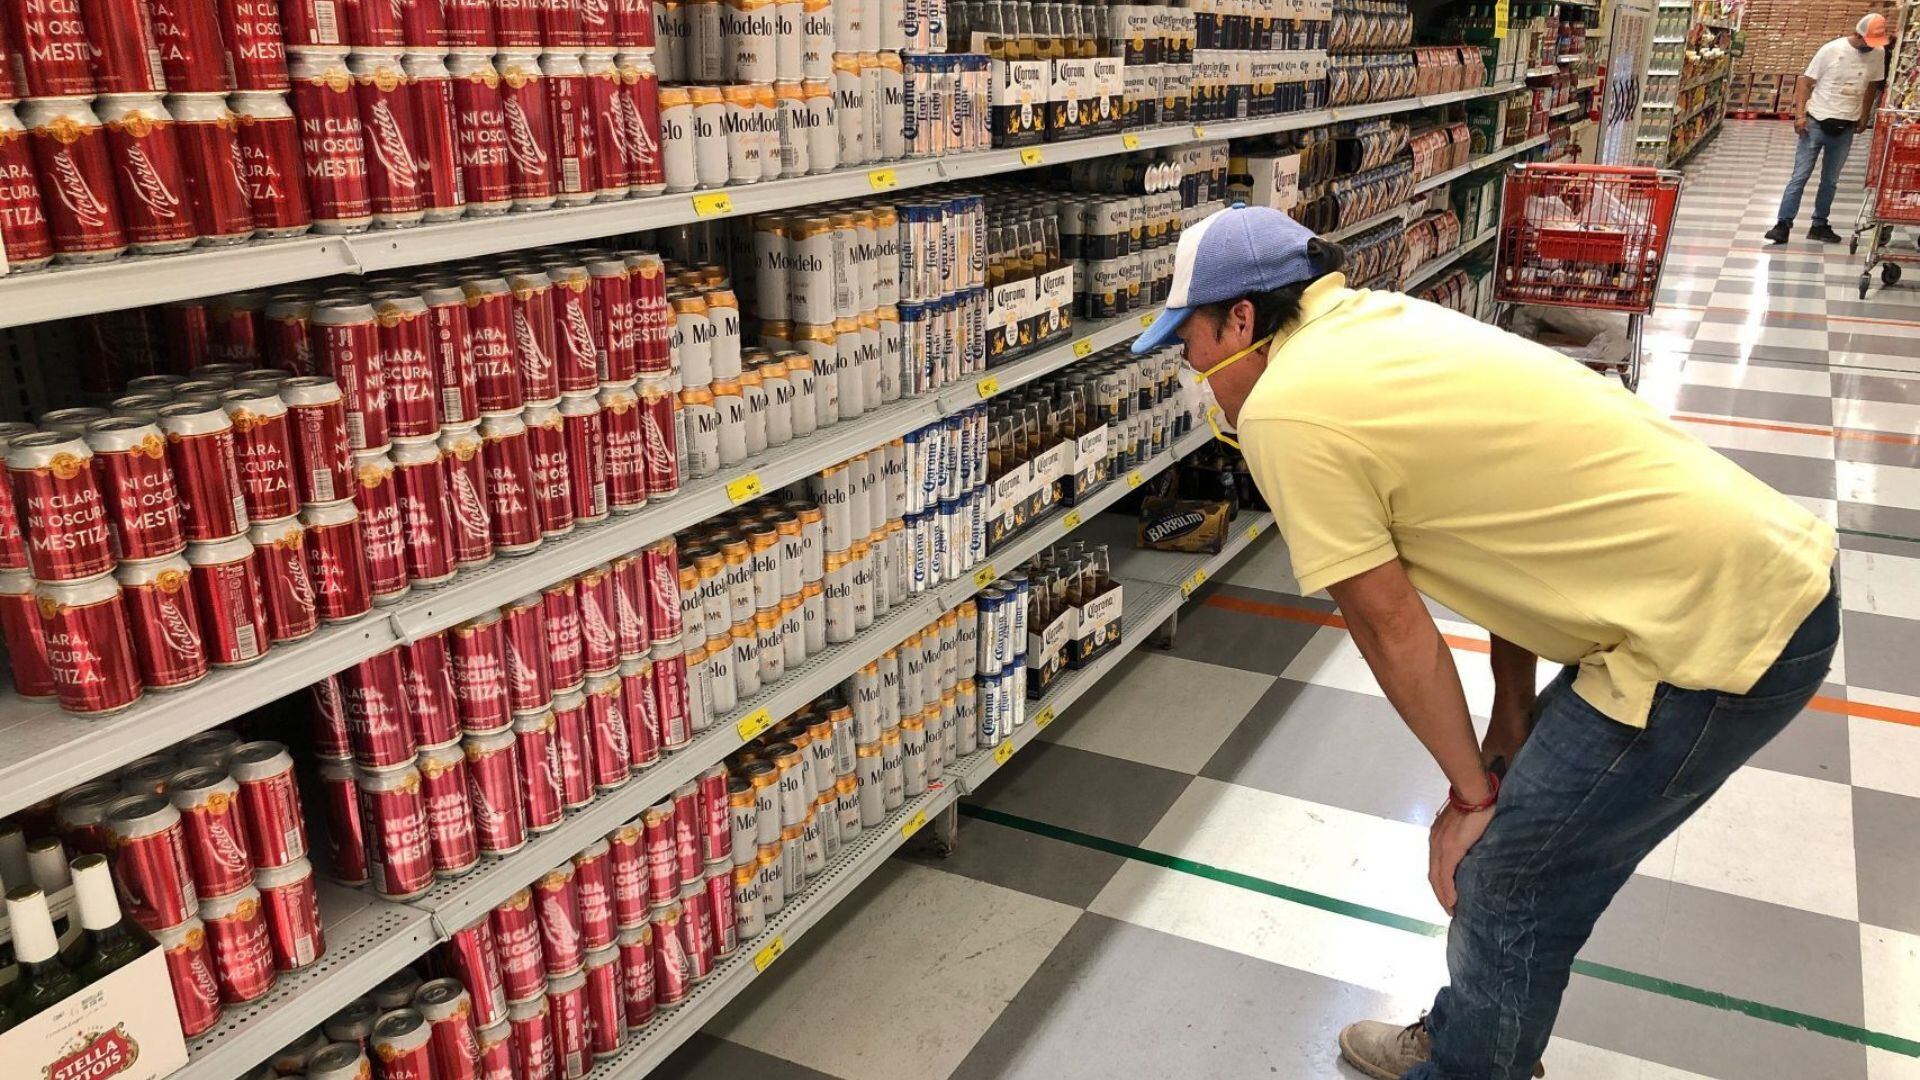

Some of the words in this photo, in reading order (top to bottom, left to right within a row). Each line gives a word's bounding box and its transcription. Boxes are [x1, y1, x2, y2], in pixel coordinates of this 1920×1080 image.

[998, 287, 1026, 306] Corona
[121, 477, 139, 491] NI
[28, 497, 43, 510] NI
[120, 496, 138, 509] NI
[28, 515, 43, 528] NI
[1088, 596, 1114, 619] Corona
[54, 1040, 118, 1080] STELLA
